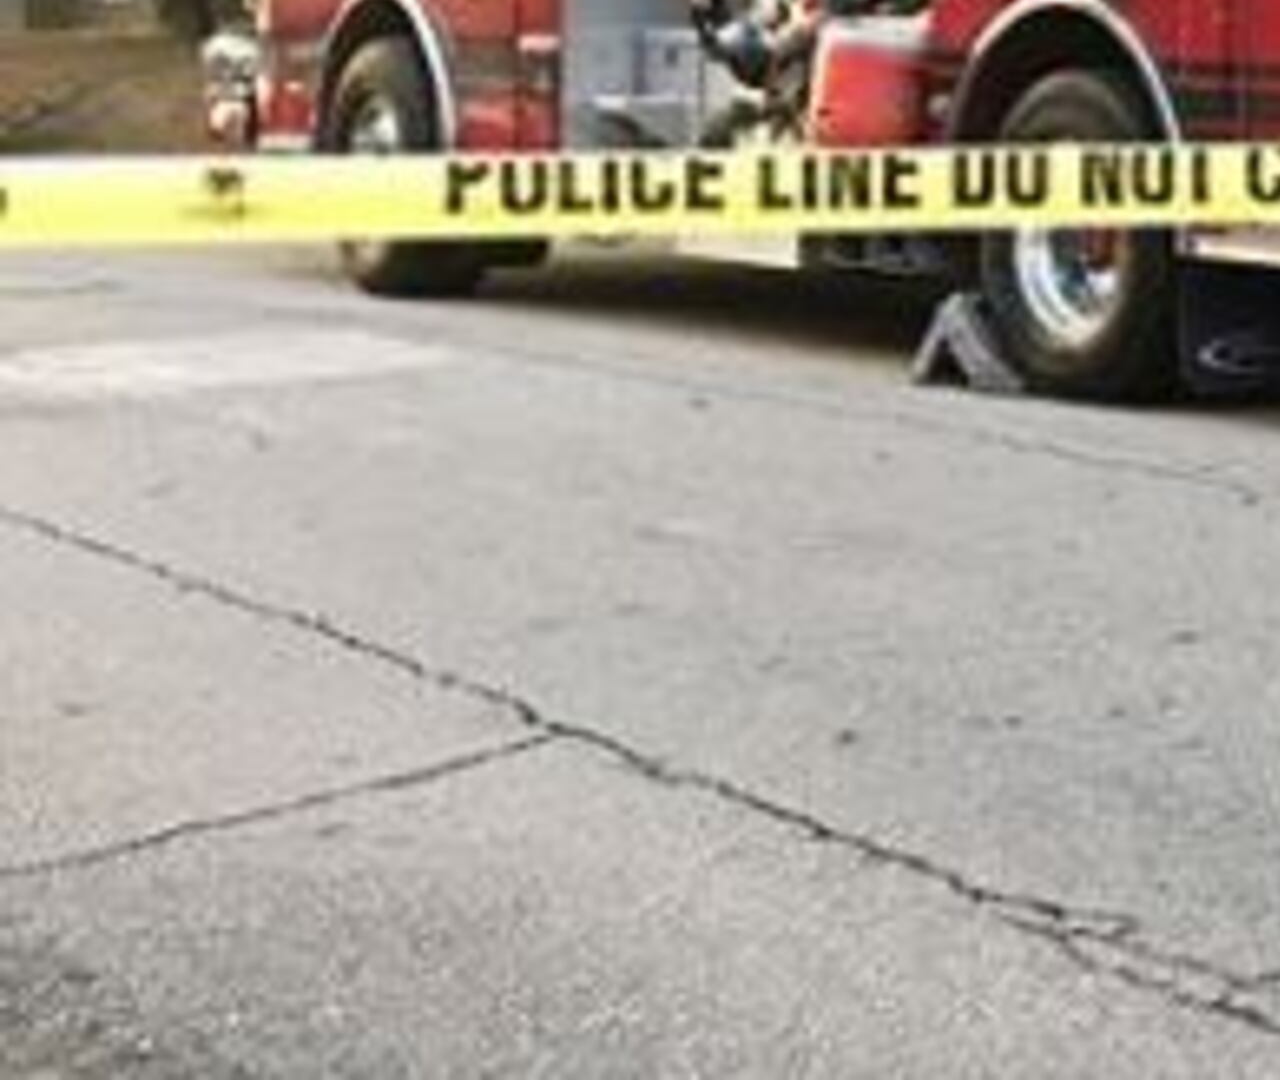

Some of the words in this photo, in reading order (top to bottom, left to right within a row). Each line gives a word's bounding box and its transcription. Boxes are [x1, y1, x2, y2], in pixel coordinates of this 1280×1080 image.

[445, 156, 727, 215] POLICE
[756, 154, 922, 212] LINE
[951, 151, 1050, 209] DO
[1079, 148, 1212, 206] NOT
